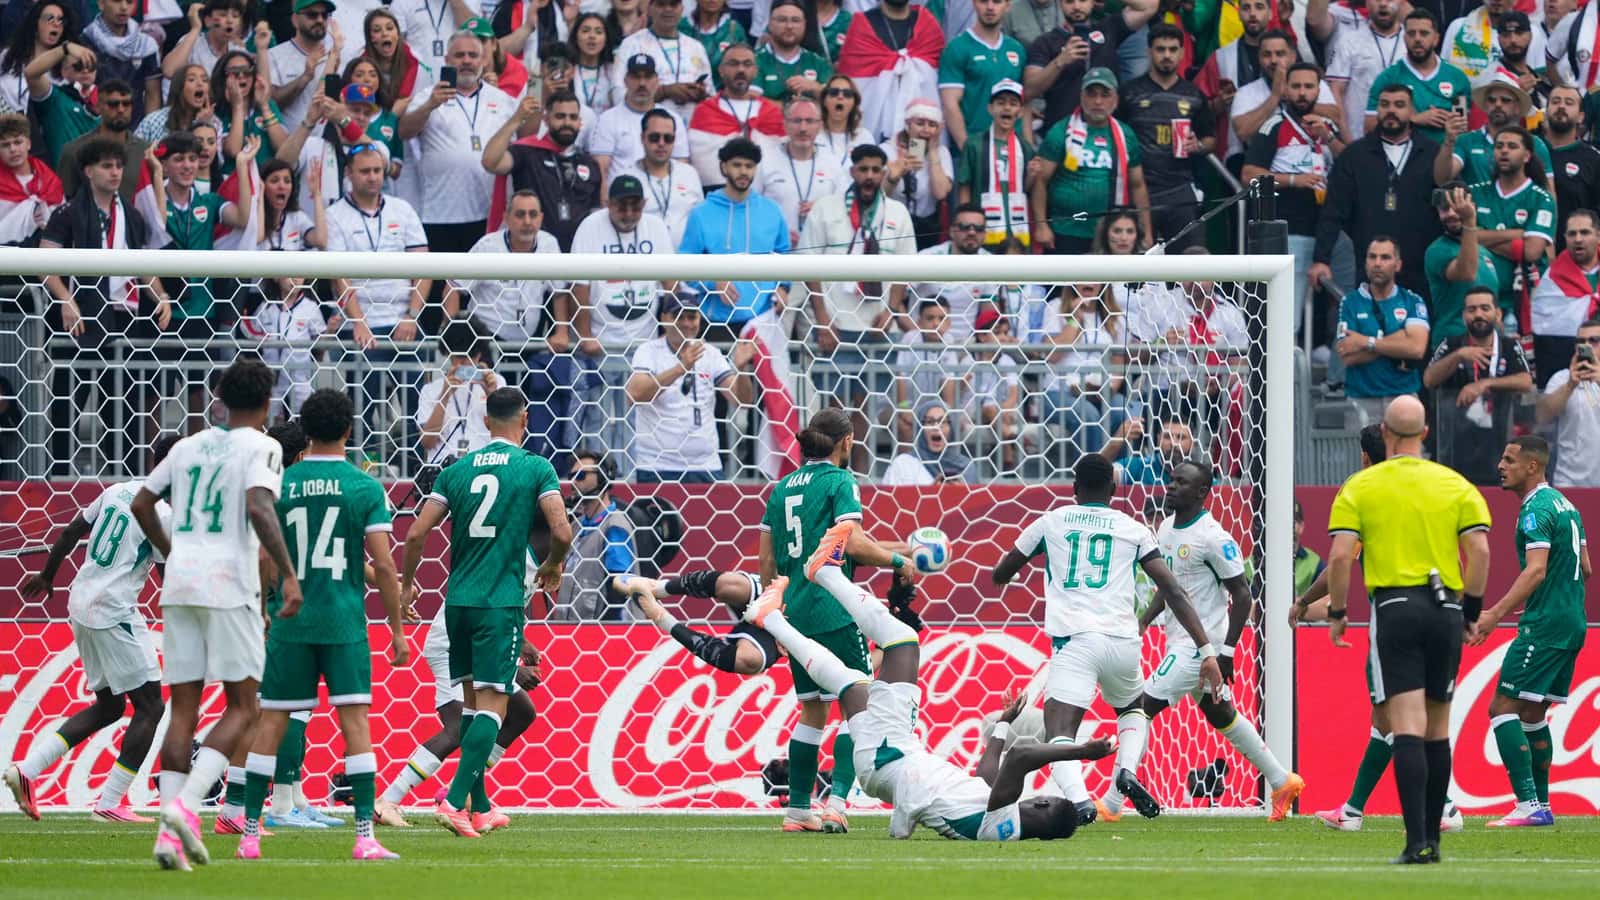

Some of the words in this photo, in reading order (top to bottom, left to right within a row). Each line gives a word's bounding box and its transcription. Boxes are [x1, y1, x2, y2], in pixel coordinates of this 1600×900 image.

[289, 482, 301, 498] Z.
[303, 479, 342, 497] IQBAL
[473, 452, 509, 467] REBIN
[176, 466, 223, 532] 14
[469, 474, 499, 538] 2
[785, 494, 803, 558] 5
[286, 506, 347, 581] 14
[1063, 529, 1112, 589] 19
